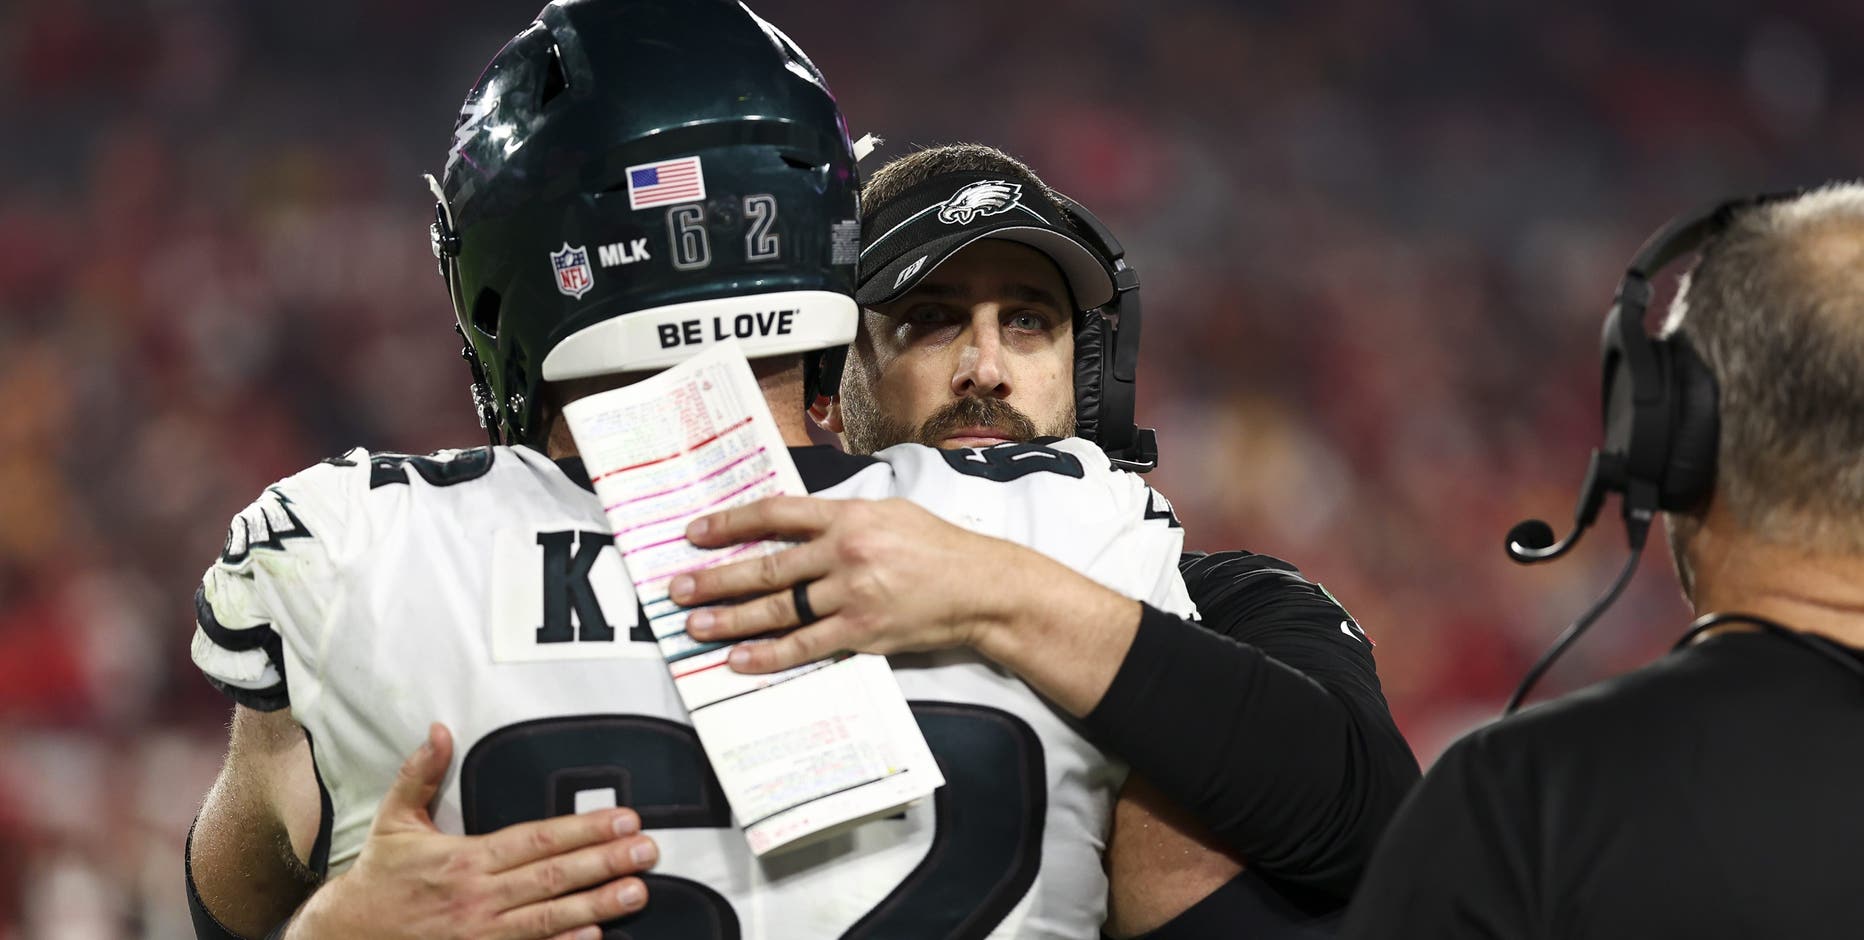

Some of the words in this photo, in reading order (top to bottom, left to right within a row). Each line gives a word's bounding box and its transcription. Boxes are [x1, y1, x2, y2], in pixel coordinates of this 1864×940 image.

[598, 237, 651, 268] MLK
[559, 268, 591, 292] NFL
[657, 319, 703, 349] BE
[713, 309, 795, 342] LOVE
